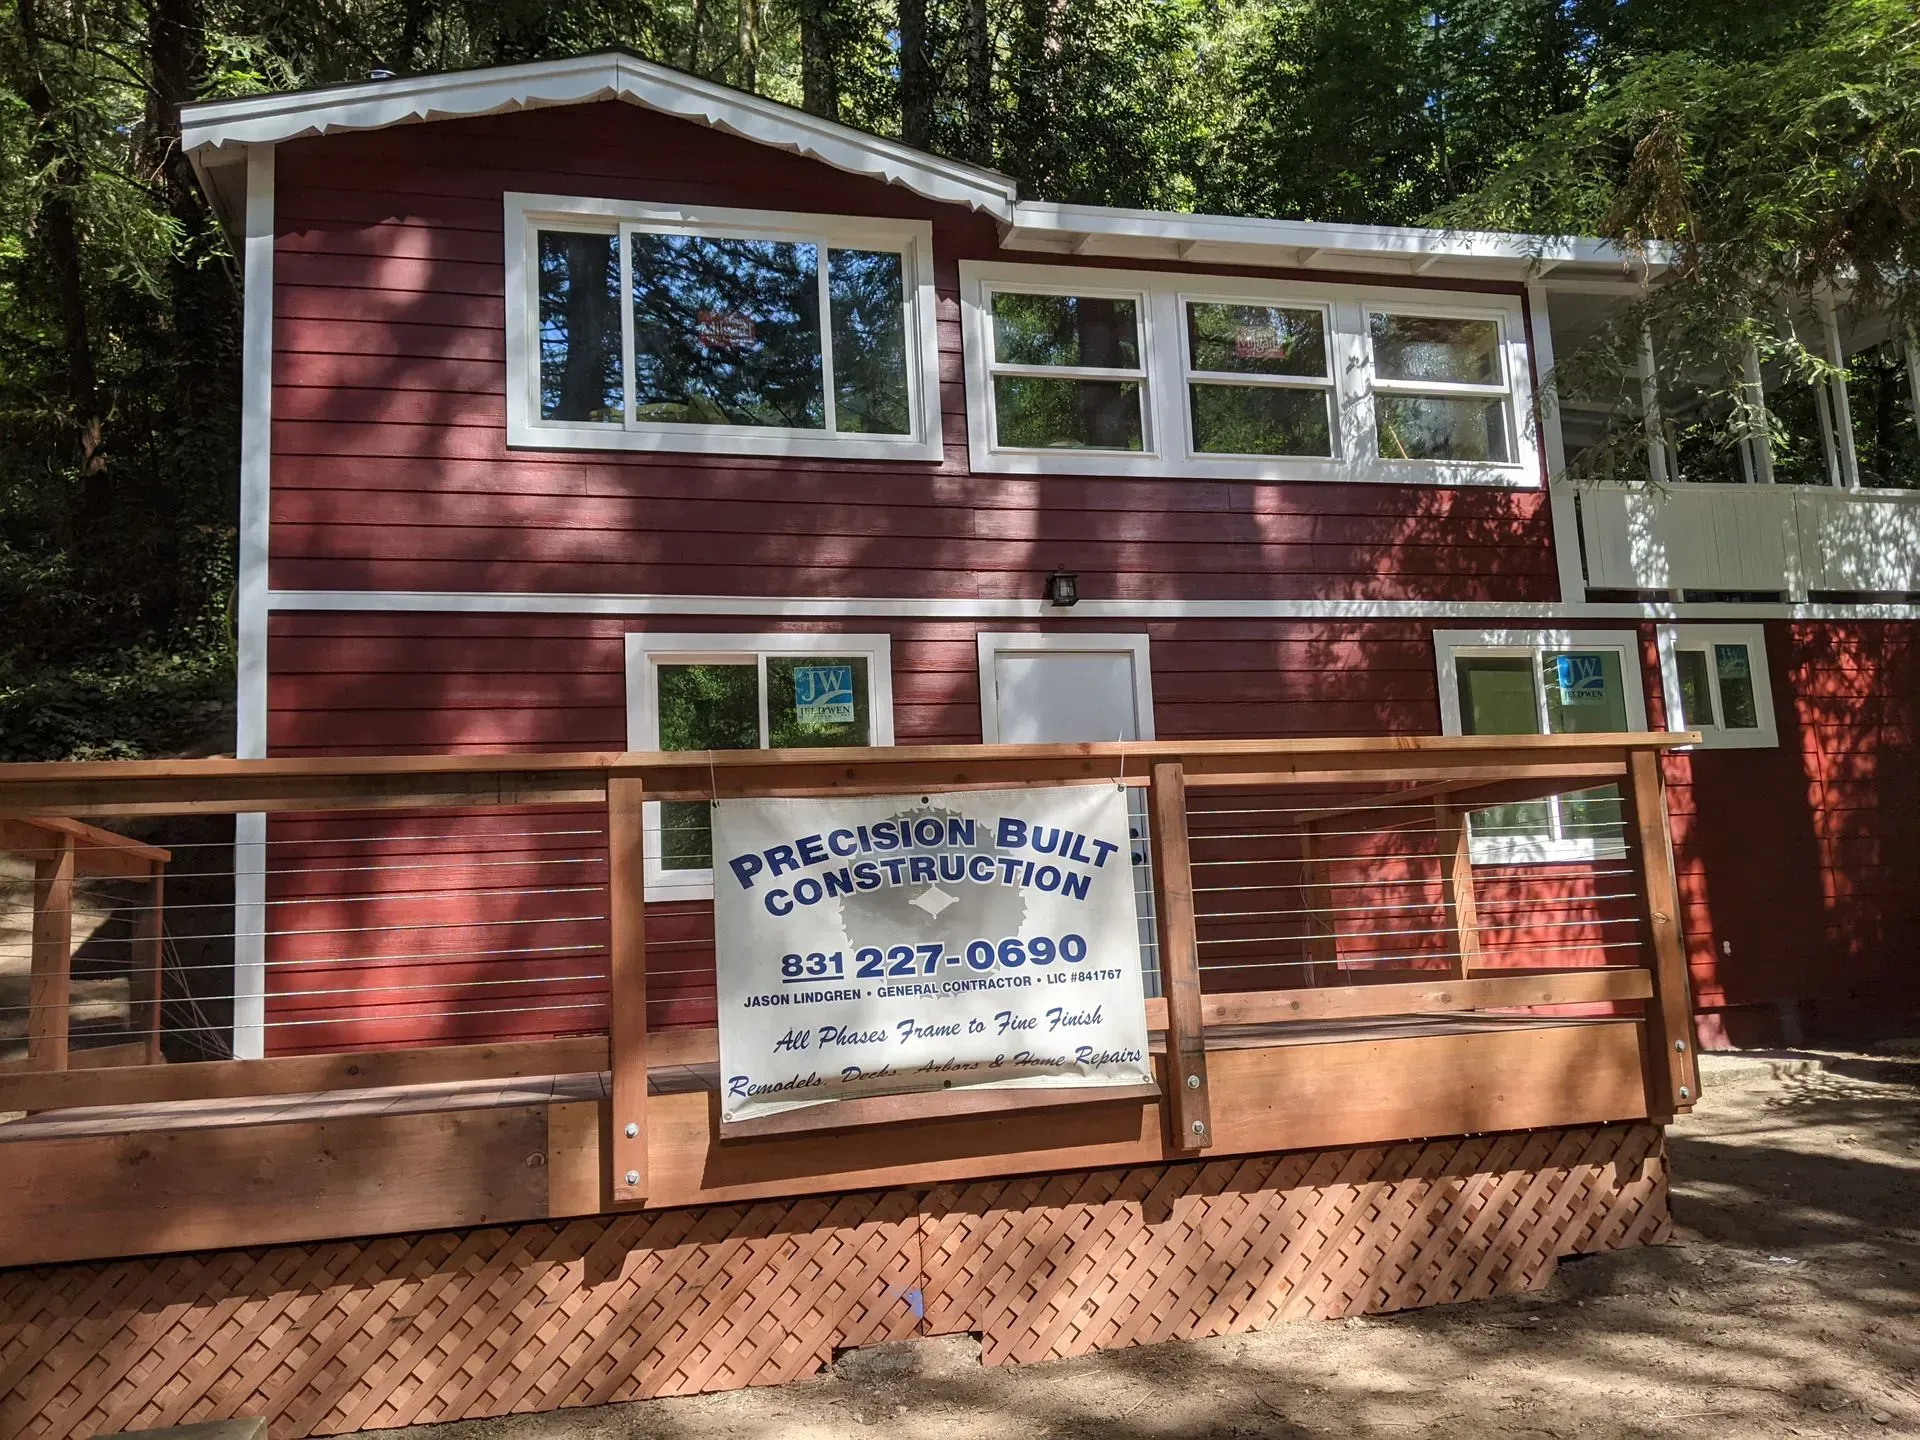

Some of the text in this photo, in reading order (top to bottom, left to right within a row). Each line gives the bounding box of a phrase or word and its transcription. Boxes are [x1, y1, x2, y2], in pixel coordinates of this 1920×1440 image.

[802, 669, 846, 701] JW
[1564, 658, 1597, 686] JW
[728, 817, 1120, 890] PRECISION BUILT
[764, 854, 1092, 917] CONSTRUCTION
[781, 933, 1087, 979] 831 227-0690
[743, 968, 1123, 1008] JASON LINDGREN GENERAL CONTRACTOR LIC #841767
[772, 1004, 1104, 1054] All Phases Frame to Fine Finish
[912, 1056, 980, 1075] Arbors
[988, 1053, 1005, 1069] &
[1012, 1050, 1067, 1068] Home
[1073, 1045, 1143, 1070] Repairs
